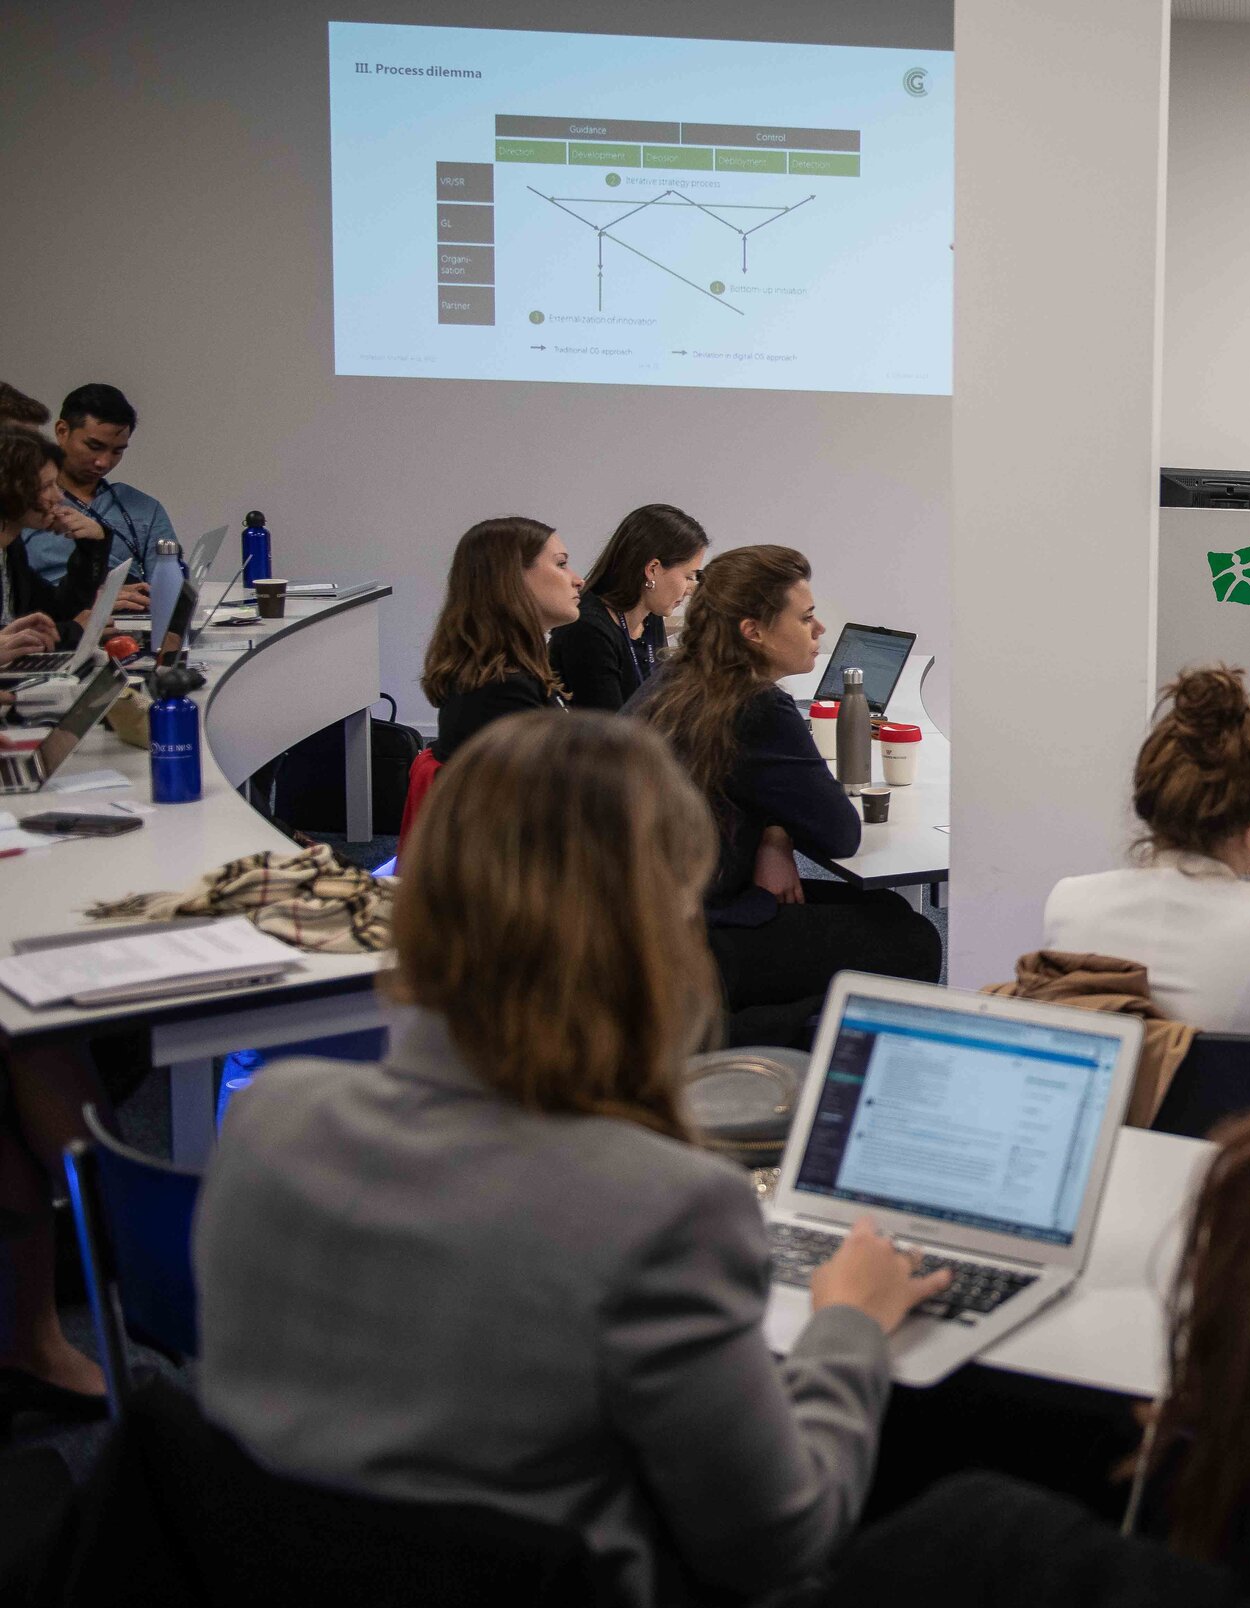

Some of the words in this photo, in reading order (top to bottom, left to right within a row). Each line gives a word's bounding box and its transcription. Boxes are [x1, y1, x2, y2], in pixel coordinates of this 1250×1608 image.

[355, 63, 372, 74] III.
[375, 64, 424, 76] Process
[426, 65, 482, 79] dilemma
[569, 125, 607, 136] Guidance
[756, 132, 786, 143] Control
[572, 149, 626, 161] Development
[792, 159, 831, 169] Detection
[440, 177, 465, 187] VR/SR
[658, 178, 689, 188] strategy
[691, 179, 721, 189] process
[441, 255, 472, 265] Organi-
[441, 266, 466, 275] sation
[441, 301, 471, 311] Partner
